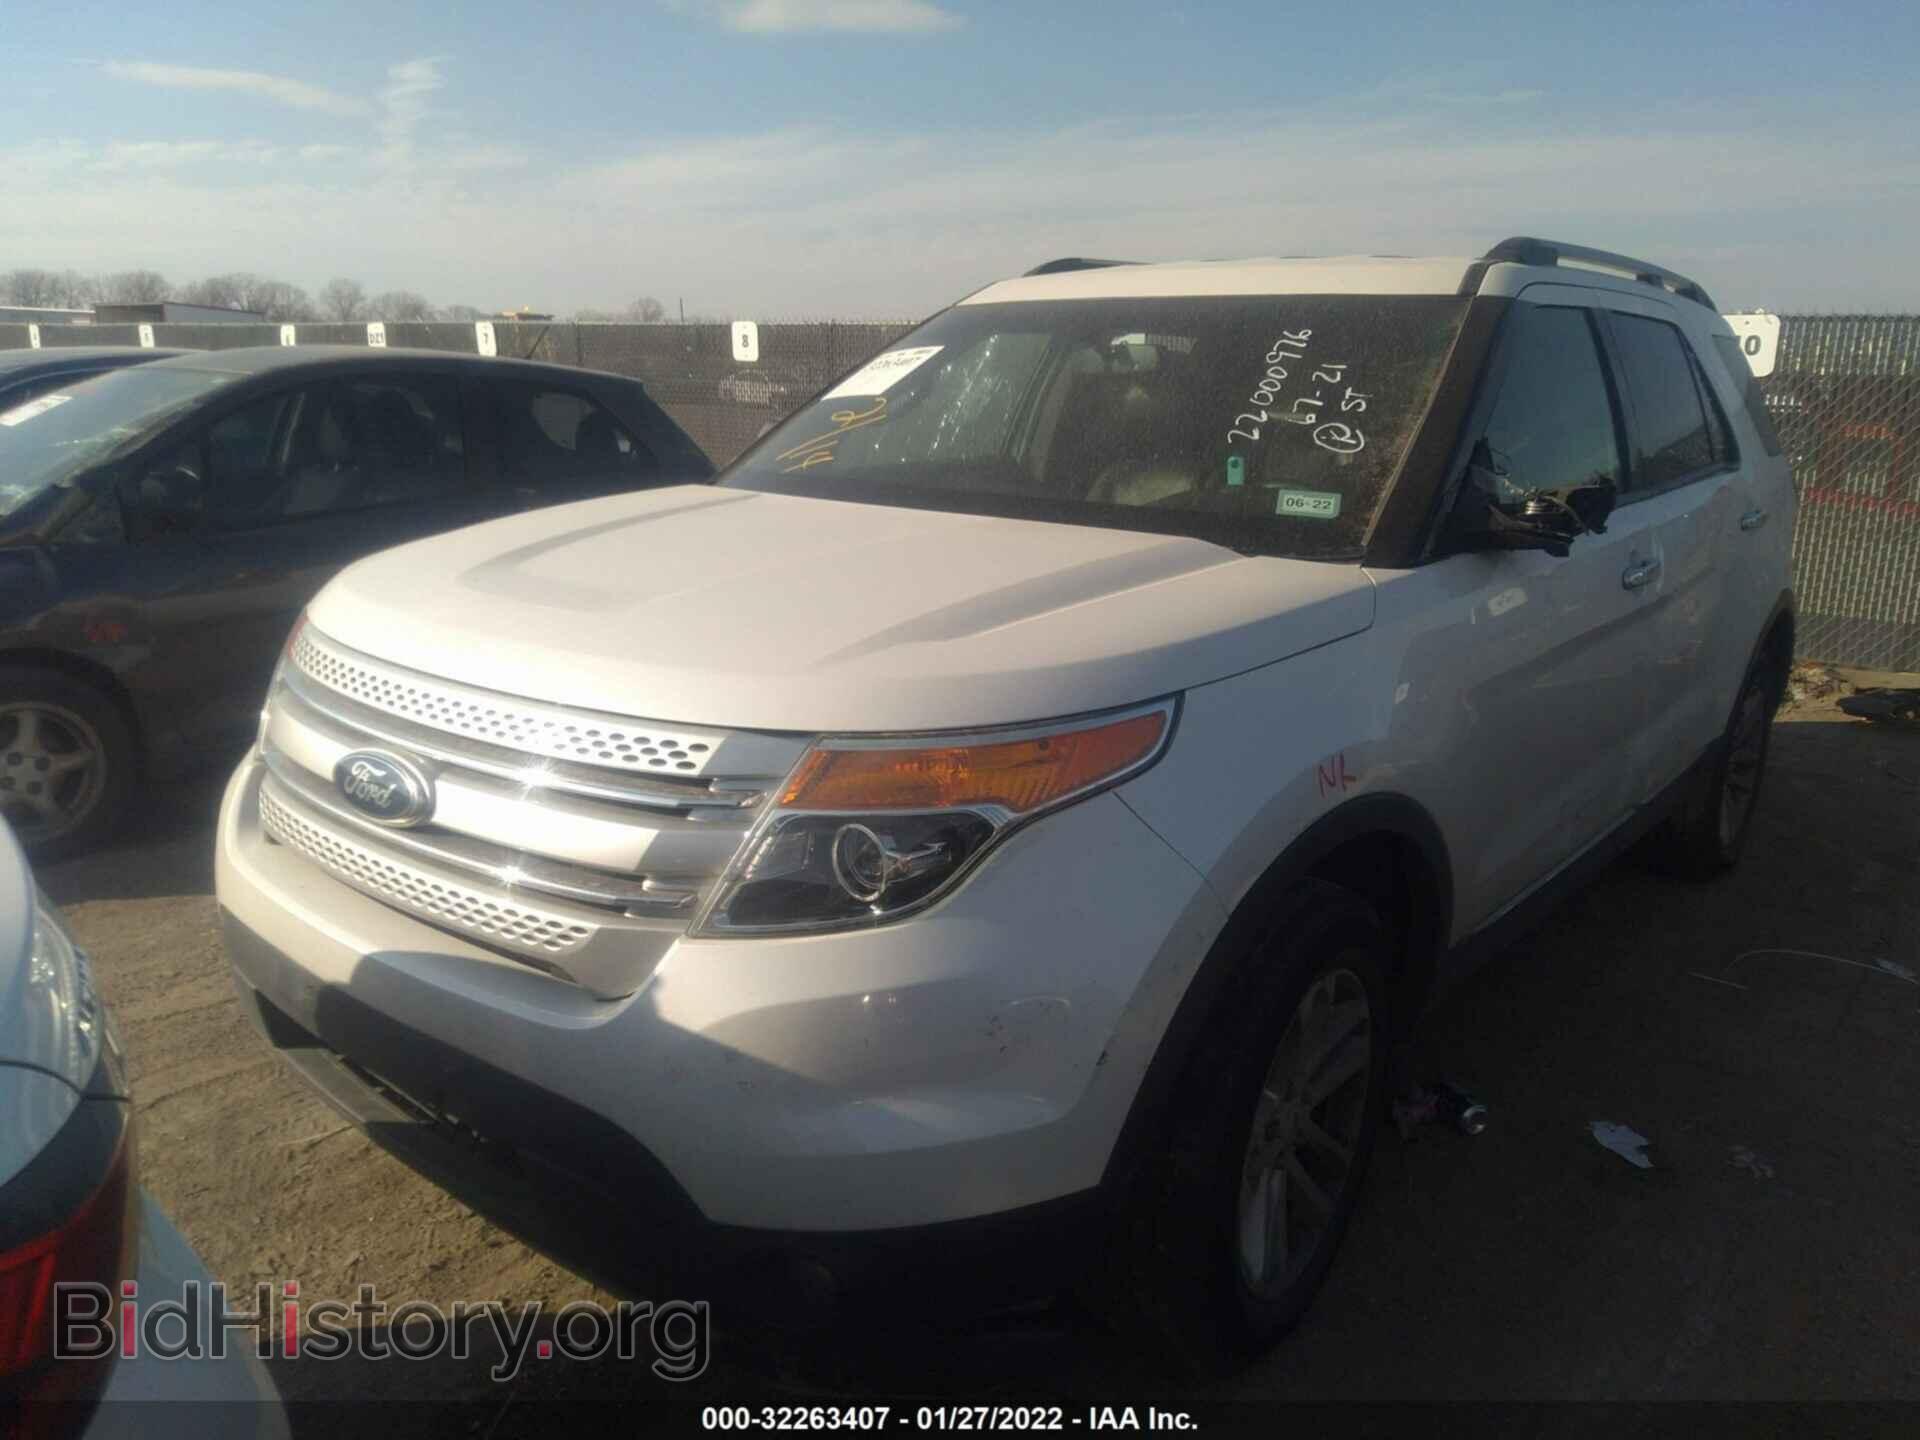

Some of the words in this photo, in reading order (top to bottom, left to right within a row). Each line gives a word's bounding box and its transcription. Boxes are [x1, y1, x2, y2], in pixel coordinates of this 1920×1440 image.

[741, 334, 750, 348] 8
[1285, 497, 1332, 510] 06-22
[343, 761, 397, 808] Ford
